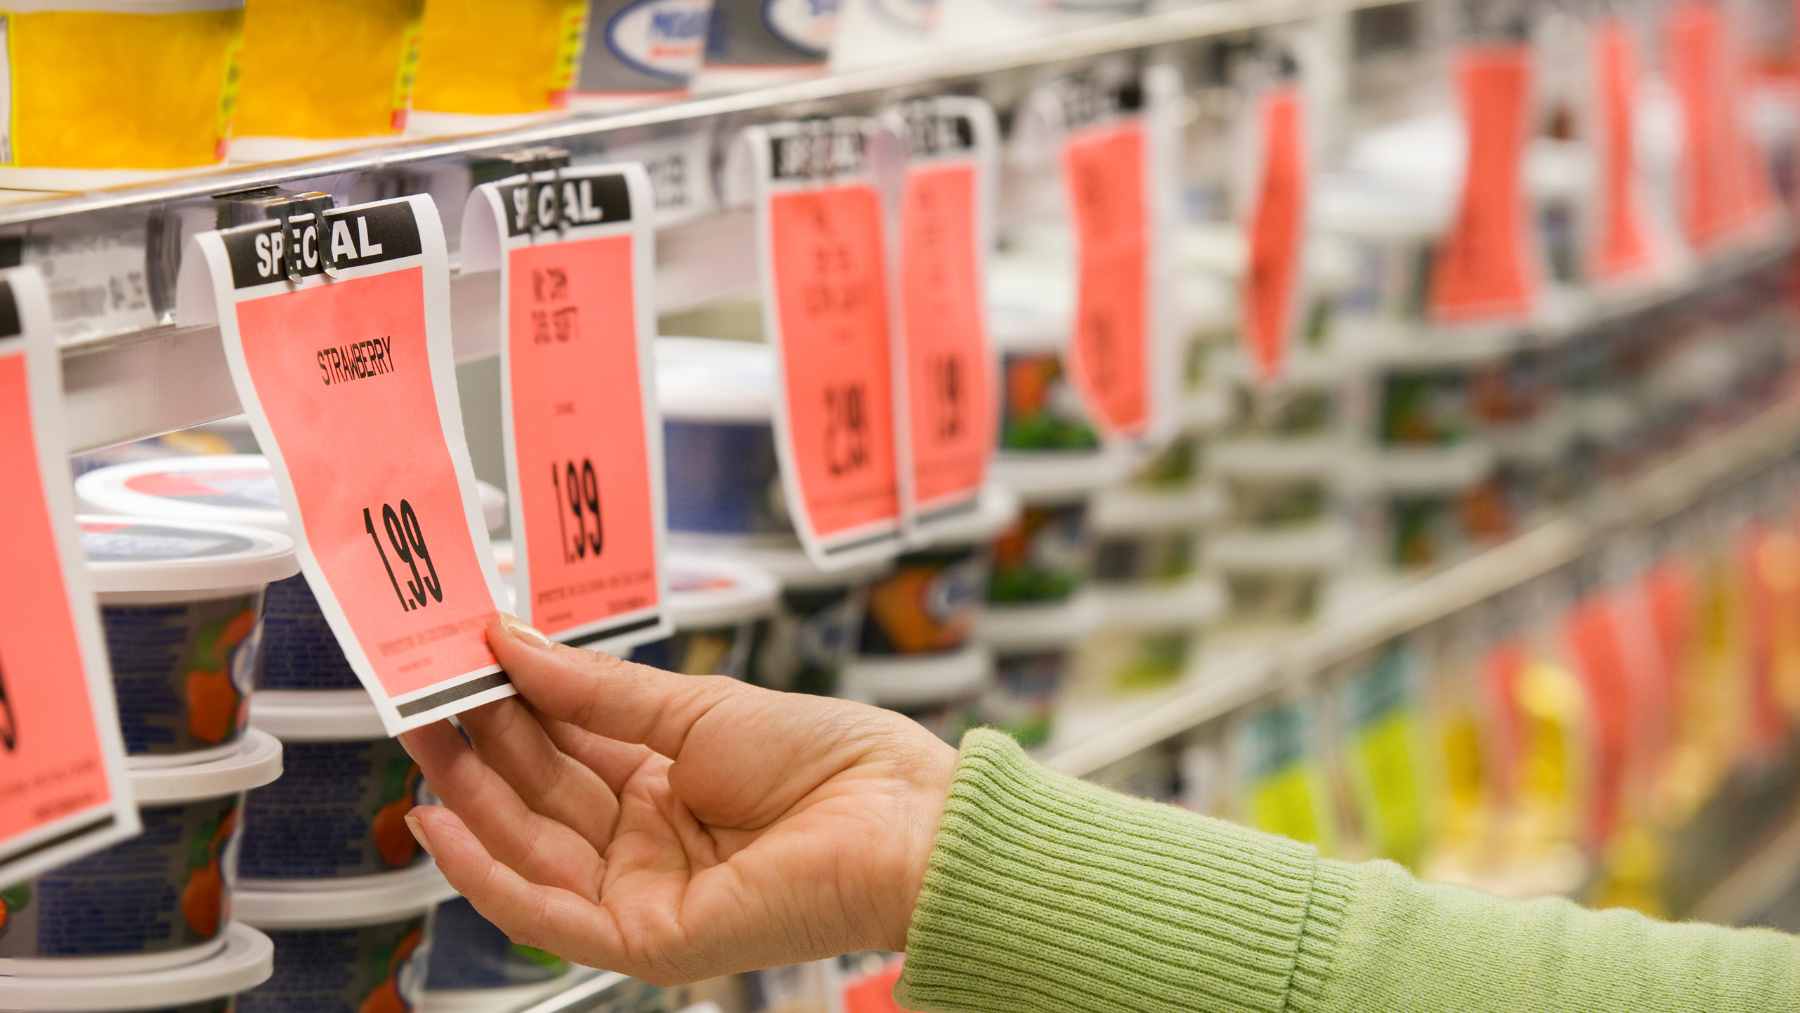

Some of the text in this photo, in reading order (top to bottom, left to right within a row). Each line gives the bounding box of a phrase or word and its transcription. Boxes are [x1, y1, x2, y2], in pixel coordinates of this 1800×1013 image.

[317, 336, 395, 386] STRAWBERRY
[362, 498, 443, 612] 1.99
[552, 457, 604, 564] 1.99
